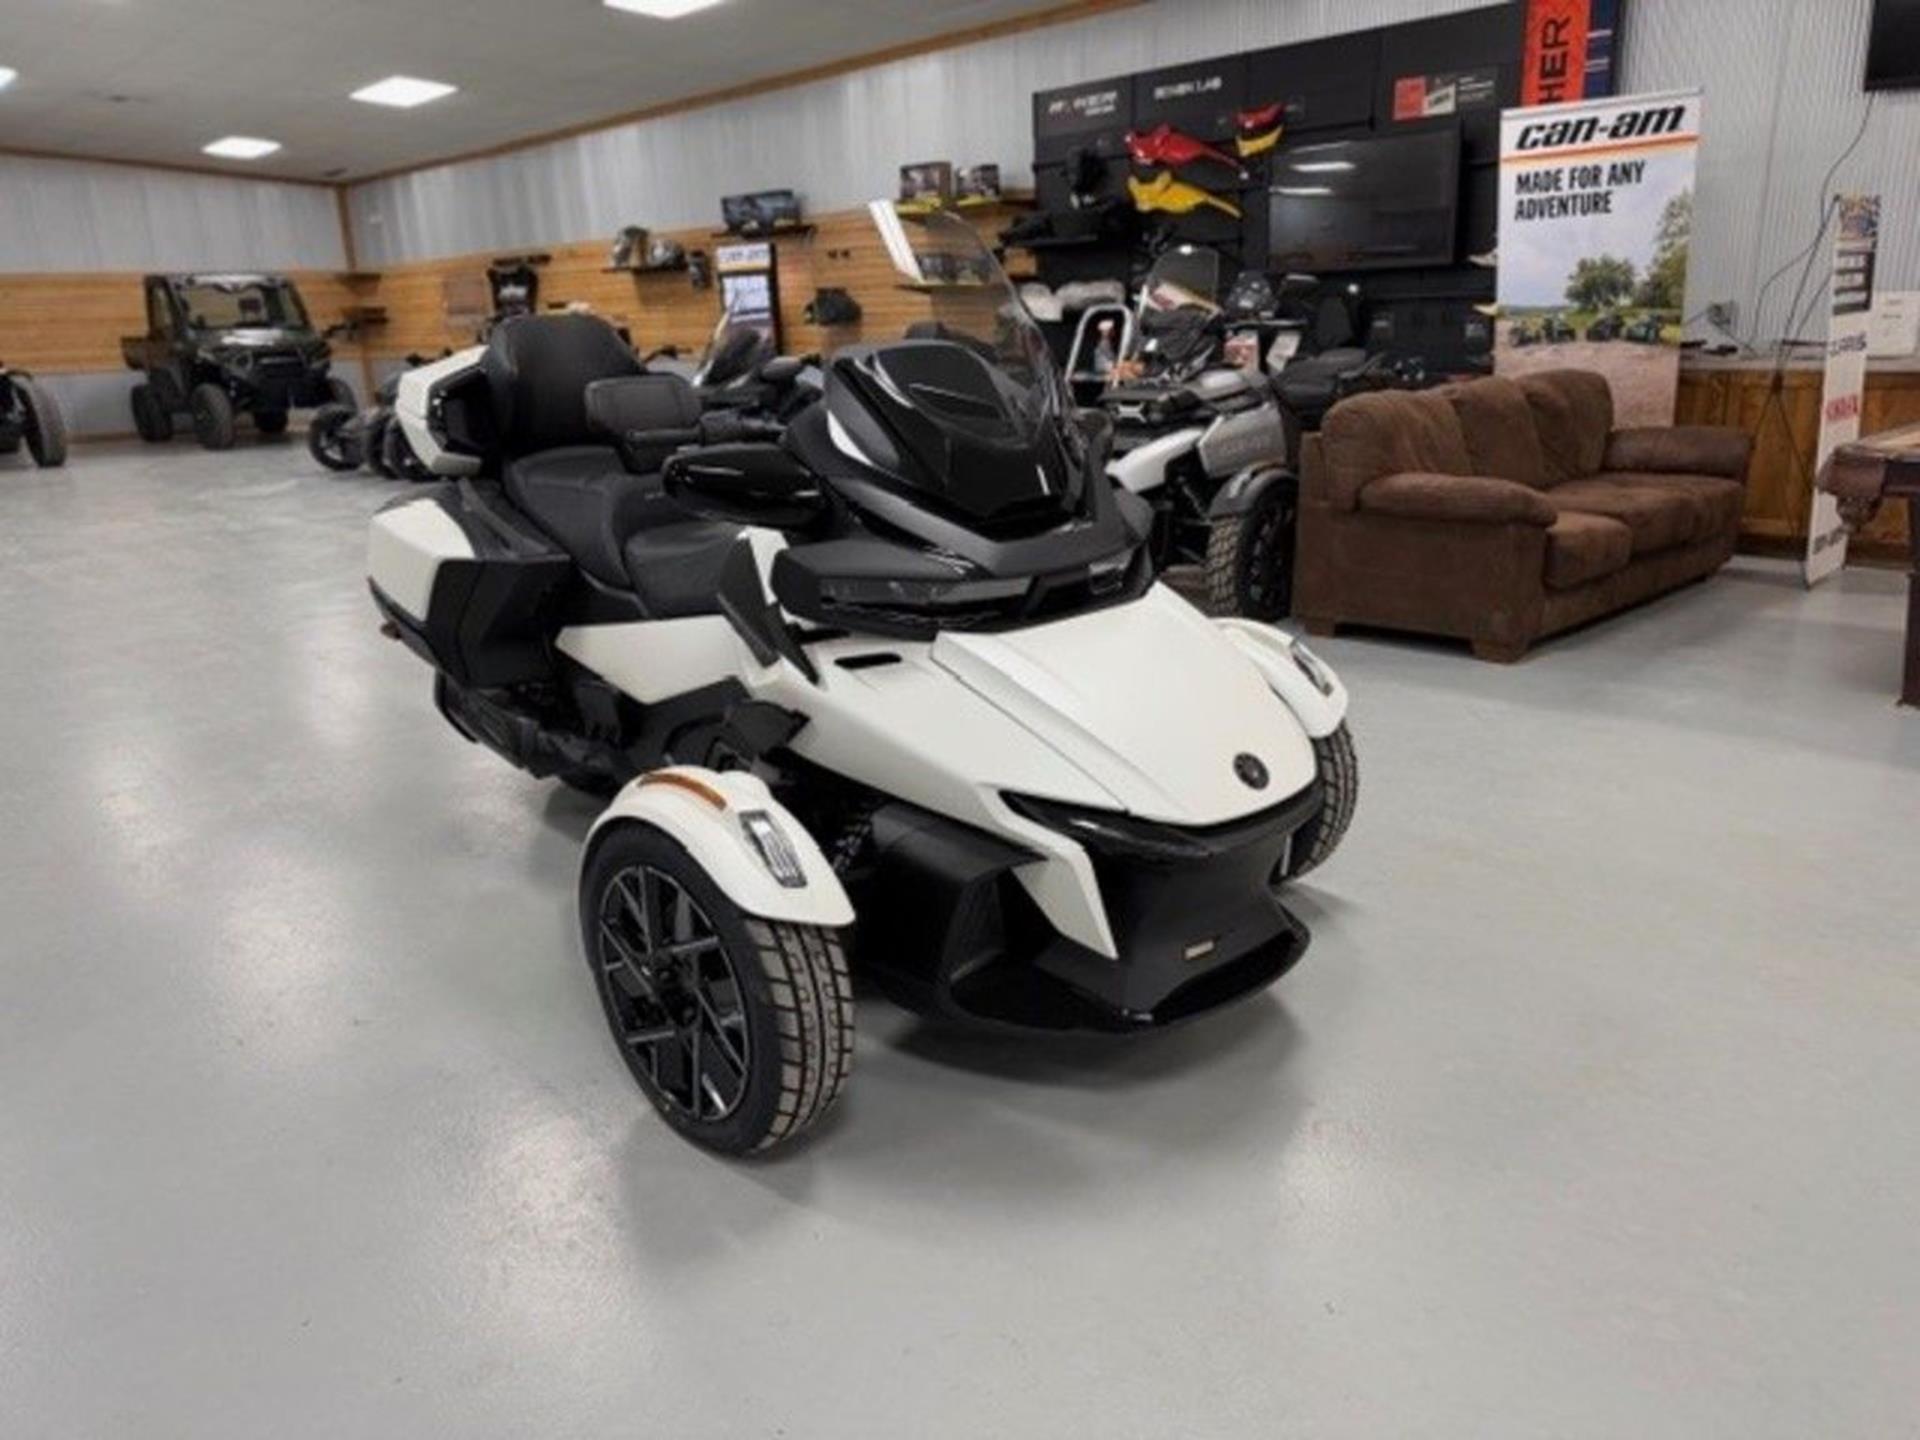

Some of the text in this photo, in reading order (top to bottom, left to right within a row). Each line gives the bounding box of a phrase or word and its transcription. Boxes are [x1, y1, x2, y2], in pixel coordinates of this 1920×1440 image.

[1516, 105, 1686, 150] can-am
[1515, 160, 1646, 196] MADE FOR ANY
[1514, 190, 1613, 221] ADVENTURE
